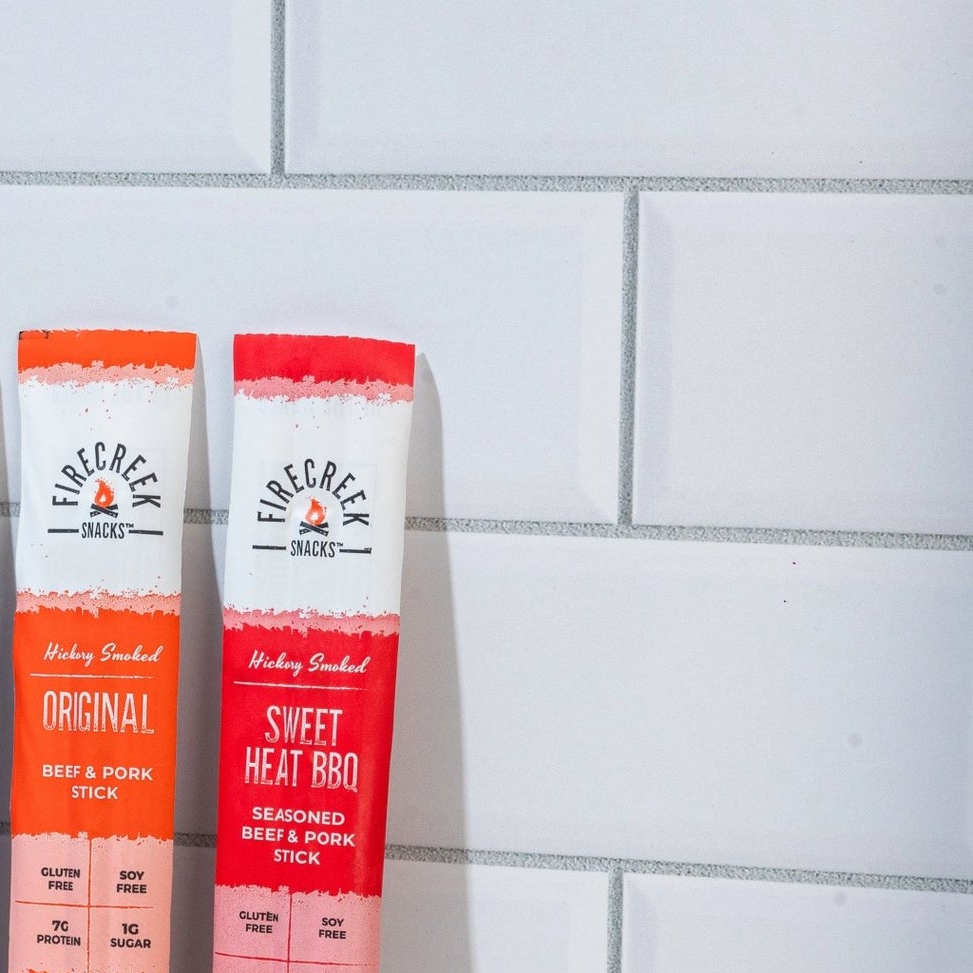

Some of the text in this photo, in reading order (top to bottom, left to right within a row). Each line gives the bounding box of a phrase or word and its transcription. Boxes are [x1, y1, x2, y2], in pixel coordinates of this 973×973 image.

[52, 441, 161, 508] FIRECREEK
[257, 458, 369, 527] FIRECREEK
[43, 642, 164, 666] Hickory Smoked
[248, 650, 370, 676] Hickory Smoked
[42, 690, 155, 734] ORIGINAL
[264, 705, 342, 747] SWEET
[42, 764, 153, 781] BEEF & PORK
[245, 746, 359, 792] HEAT BBQ
[71, 786, 118, 799] STICK
[252, 807, 345, 825] SEASONED
[241, 826, 355, 847] BEEF & PORK
[274, 849, 320, 865] STICK
[41, 867, 81, 878] GLUTEN
[119, 871, 144, 880] SOY
[48, 881, 73, 891] FREE
[117, 884, 147, 893] FREE
[239, 911, 279, 922] GLUTEN
[322, 918, 345, 927] SOY
[52, 920, 69, 932] 7G
[122, 923, 139, 935] 1G
[245, 923, 273, 933] FREE
[37, 935, 81, 946] PROTEIN
[319, 930, 347, 939] FREE
[110, 938, 151, 948] SUGAR
